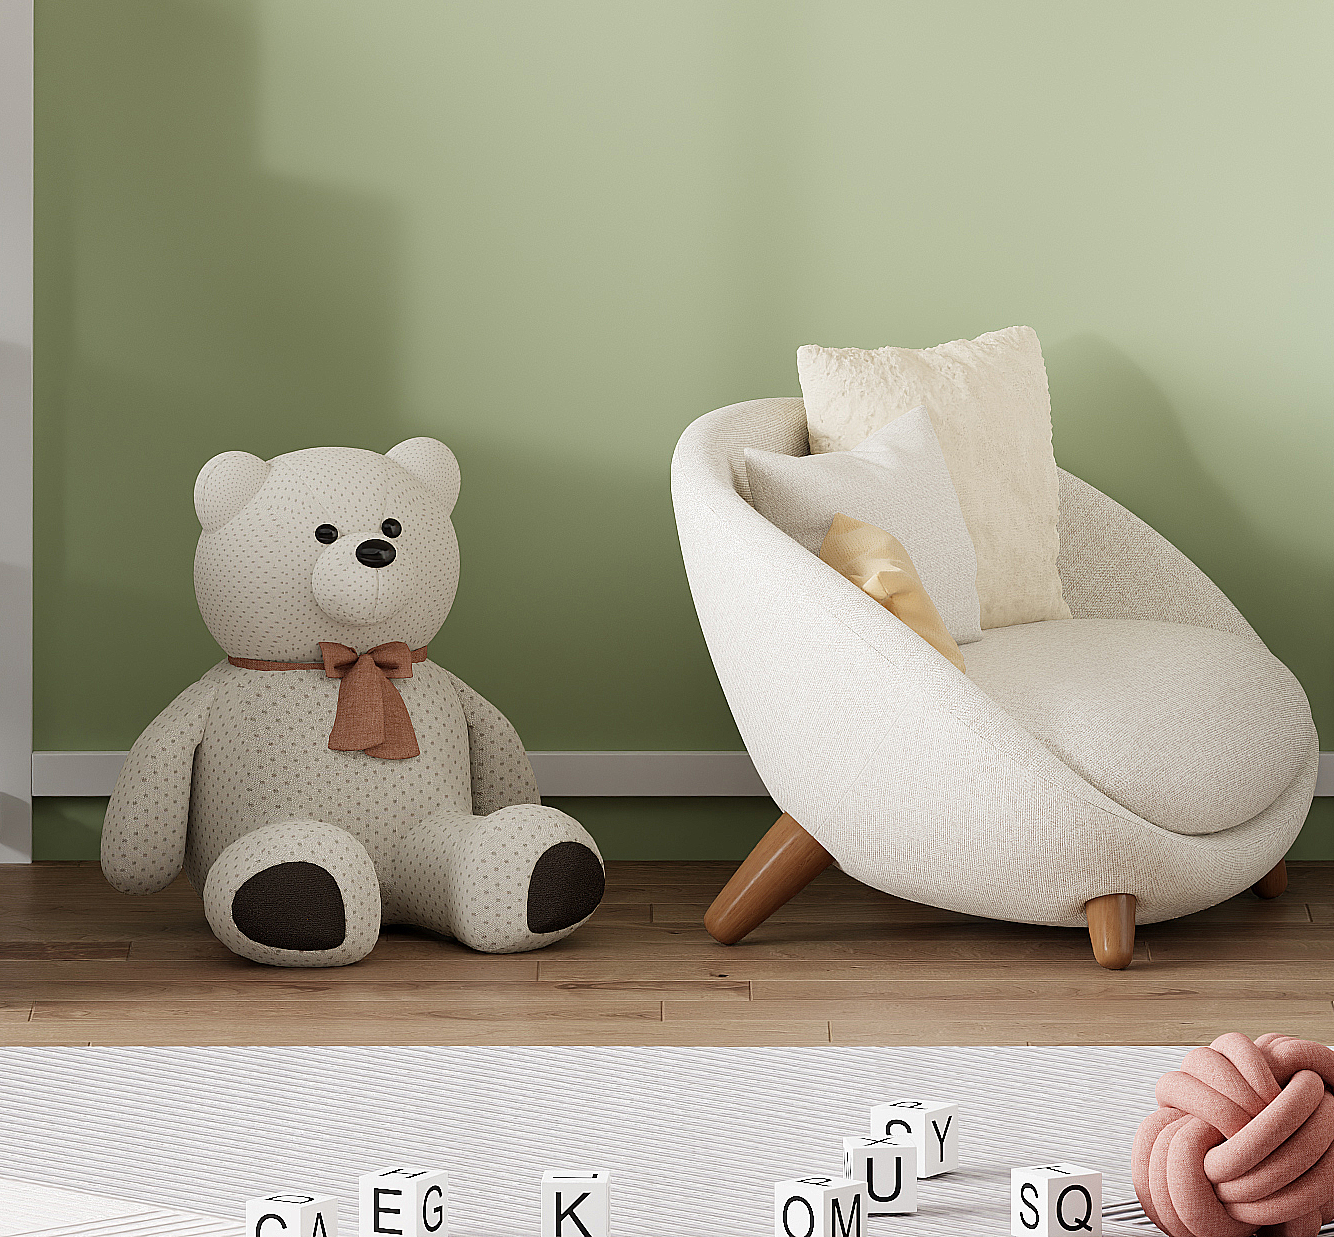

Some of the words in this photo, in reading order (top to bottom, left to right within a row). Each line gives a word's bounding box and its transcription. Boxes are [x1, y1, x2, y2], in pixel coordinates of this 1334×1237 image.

[931, 1115, 953, 1163] Y
[866, 1156, 902, 1203] U
[373, 1187, 403, 1235] E
[422, 1184, 444, 1233] G
[555, 1191, 593, 1237] K
[831, 1193, 861, 1237] M
[1019, 1182, 1040, 1230] S
[1056, 1184, 1093, 1232] Q
